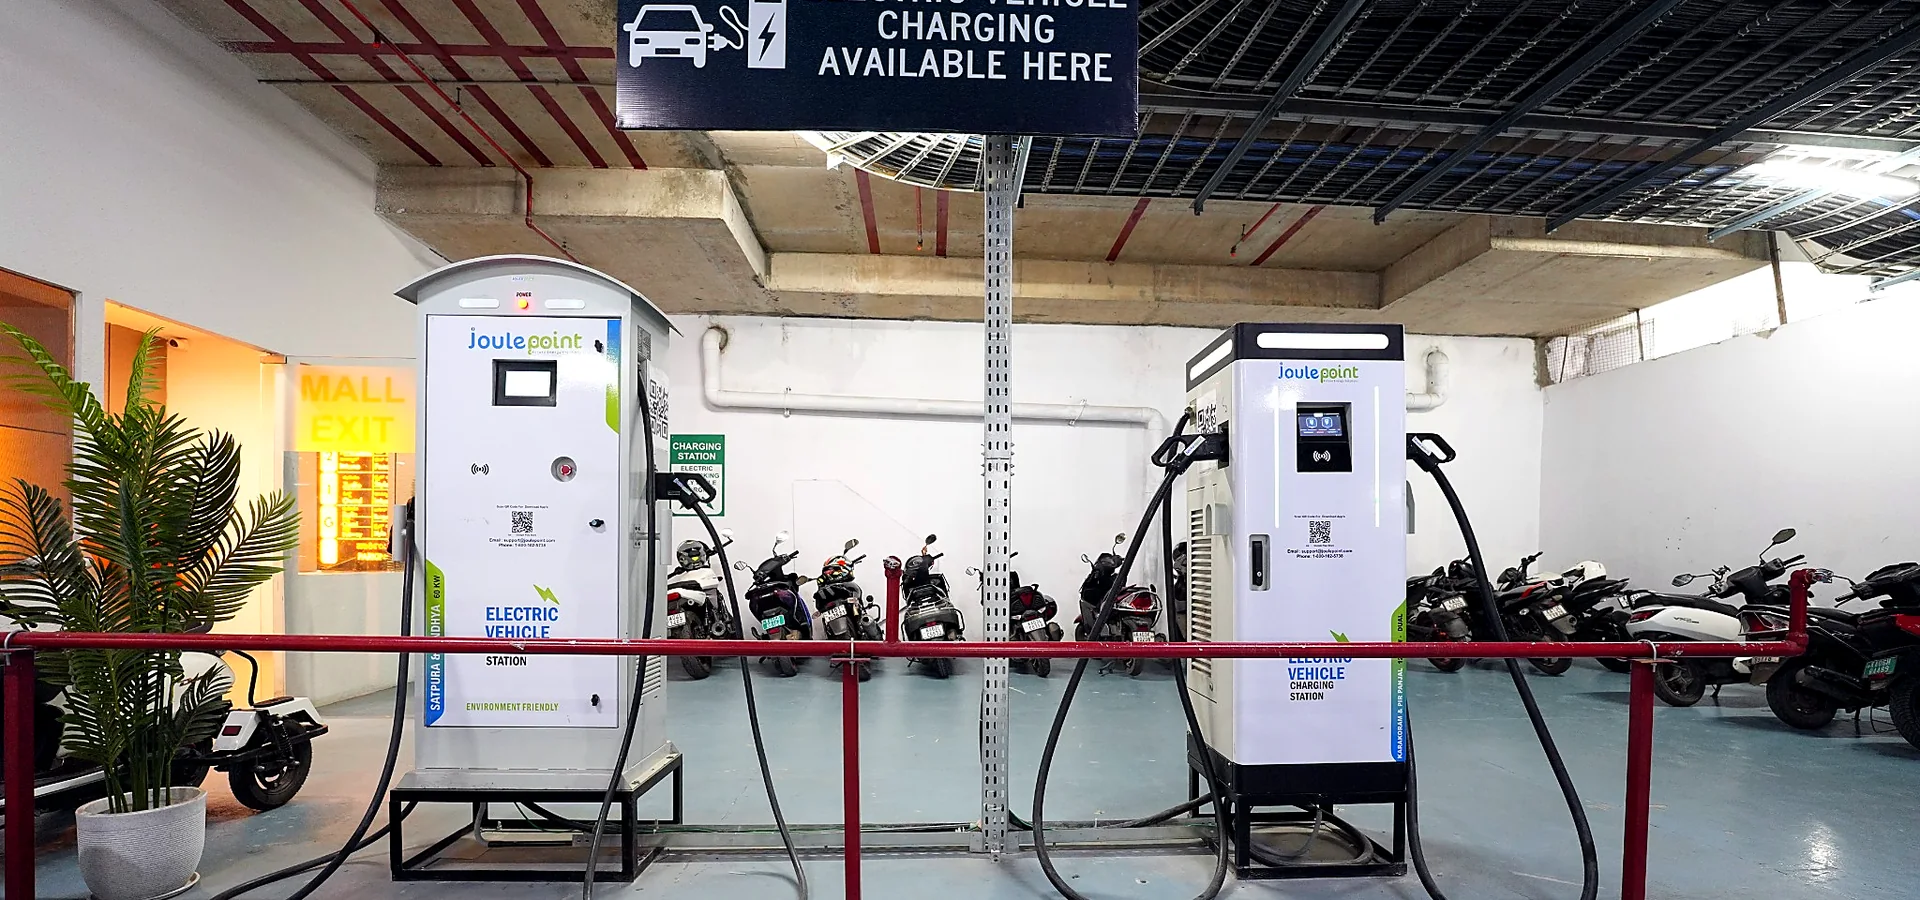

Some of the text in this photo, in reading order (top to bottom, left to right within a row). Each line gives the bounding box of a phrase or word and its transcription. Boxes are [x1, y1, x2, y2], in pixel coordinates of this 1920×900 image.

[878, 10, 1055, 44] CHARGING
[818, 46, 1113, 83] AVAILABLE HERE
[301, 375, 405, 403] MALL
[311, 415, 394, 443] EXIT
[672, 442, 722, 451] CHARGING
[677, 452, 717, 461] STATION
[433, 575, 441, 588] KW
[485, 606, 559, 622] ELECTRIC
[1396, 613, 1404, 632] DUAL
[485, 625, 551, 639] VEHICLE
[486, 656, 527, 666] STATION
[1287, 666, 1345, 680] VEHICLE
[430, 663, 442, 711] SATPURA
[1290, 681, 1335, 690] CHARGING
[1396, 668, 1404, 693] PANJAL
[1289, 692, 1325, 701] STATION
[1396, 695, 1404, 707] PIR
[466, 702, 559, 711] ENVIRONMENT FRIENDLY
[1396, 716, 1404, 759] KARAKORAM
